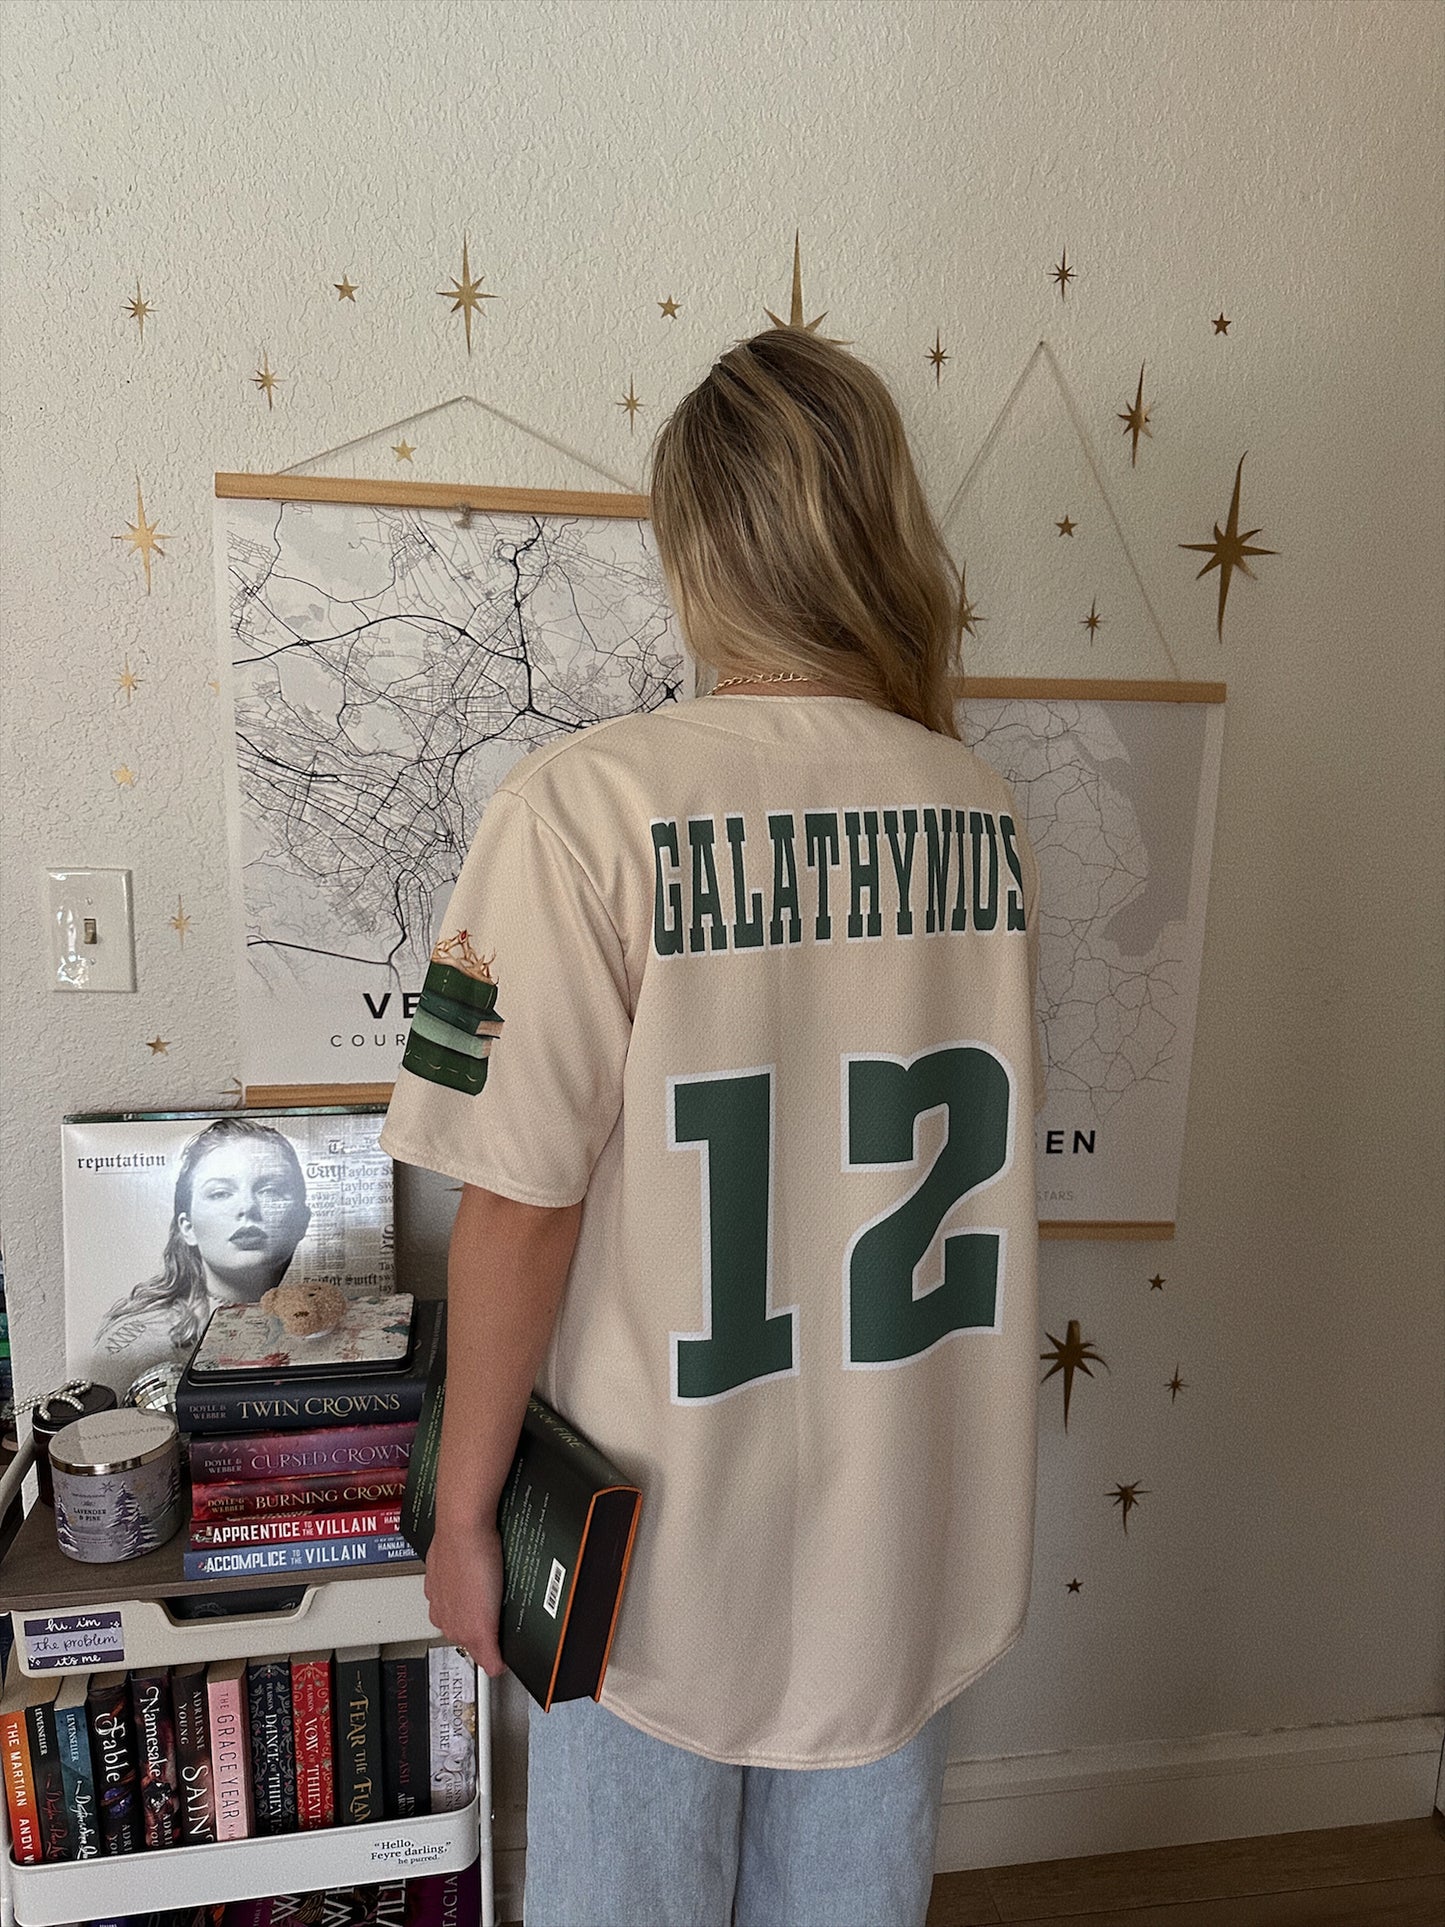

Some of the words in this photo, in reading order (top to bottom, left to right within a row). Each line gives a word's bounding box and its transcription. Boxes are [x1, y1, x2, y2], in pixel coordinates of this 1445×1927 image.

[651, 805, 1027, 959] GALATHYNIUS
[77, 1152, 166, 1172] reputation
[665, 1039, 1018, 1407] 12
[193, 1411, 227, 1420] WEBBER
[236, 1400, 300, 1420] TWIN
[304, 1393, 401, 1418] CROWNS
[552, 1427, 586, 1448] FIRE
[204, 1459, 233, 1468] DOYLE
[208, 1465, 242, 1474] WEBBER
[251, 1451, 327, 1471] CURSED
[331, 1443, 412, 1466] CROWN
[255, 1492, 338, 1510] BURNING
[212, 1521, 300, 1544] APPRENTICE
[315, 1516, 377, 1536] VILLAIN
[206, 1550, 287, 1573] ACCOMPLICE
[305, 1543, 367, 1565] VILLAIN
[378, 1541, 405, 1551] HANNAH
[33, 1637, 60, 1652] the
[64, 1633, 118, 1651] problem
[82, 1654, 101, 1663] me
[220, 1692, 230, 1710] THE
[439, 1671, 450, 1707] FLESH
[192, 1691, 205, 1750] ADRIENNE
[452, 1676, 463, 1737] KINGDOM
[6, 1722, 20, 1746] THE
[139, 1685, 168, 1778] Namesake
[178, 1702, 189, 1746] YOUNG
[304, 1717, 319, 1755] VOW
[346, 1695, 370, 1749] FEAR
[94, 1712, 129, 1783] Fable
[216, 1714, 238, 1772] GRACE
[440, 1724, 450, 1749] FIRE
[355, 1749, 368, 1774] THE
[10, 1750, 28, 1807] MARTIAN
[181, 1765, 214, 1842] SAIN
[219, 1777, 240, 1820] YEAR
[18, 1818, 34, 1852] ANDY
[370, 1850, 403, 1861] Feyre
[397, 1856, 408, 1865] he
